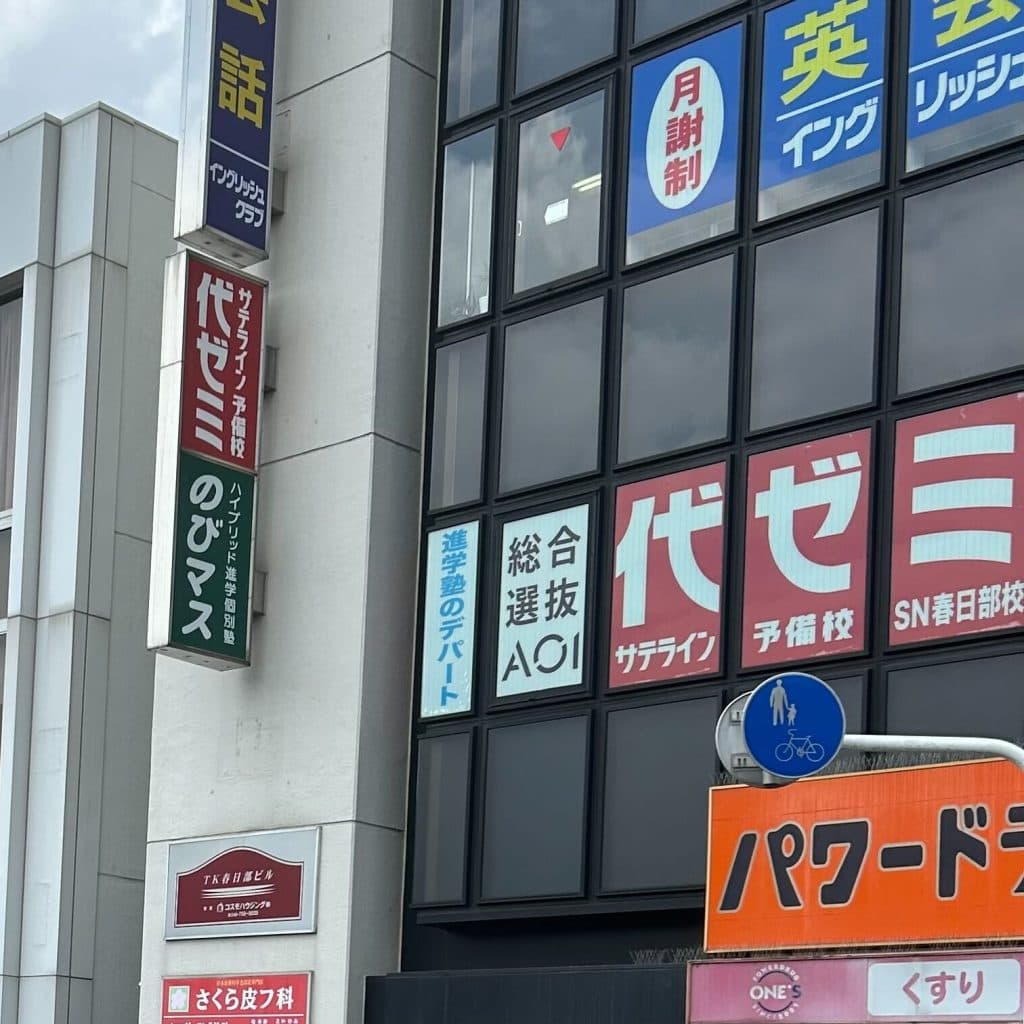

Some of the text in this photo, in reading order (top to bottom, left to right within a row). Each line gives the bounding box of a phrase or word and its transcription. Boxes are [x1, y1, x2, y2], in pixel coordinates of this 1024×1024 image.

[664, 65, 704, 197] 月謝制
[209, 162, 265, 206] イングリッシュ
[235, 199, 265, 228] クラブ
[195, 272, 234, 452] 代ゼミ
[181, 474, 224, 640] のびマス
[507, 524, 581, 578] 総合
[438, 529, 469, 707] 進学塾のデパート
[504, 577, 579, 629] 選抜
[614, 580, 1024, 677] サテライン 予備校 SN春日部校
[501, 632, 579, 682] AOI
[196, 986, 294, 1011] さくら皮フ科
[749, 984, 802, 1000] ONE'S
[902, 970, 985, 1005] くすり
